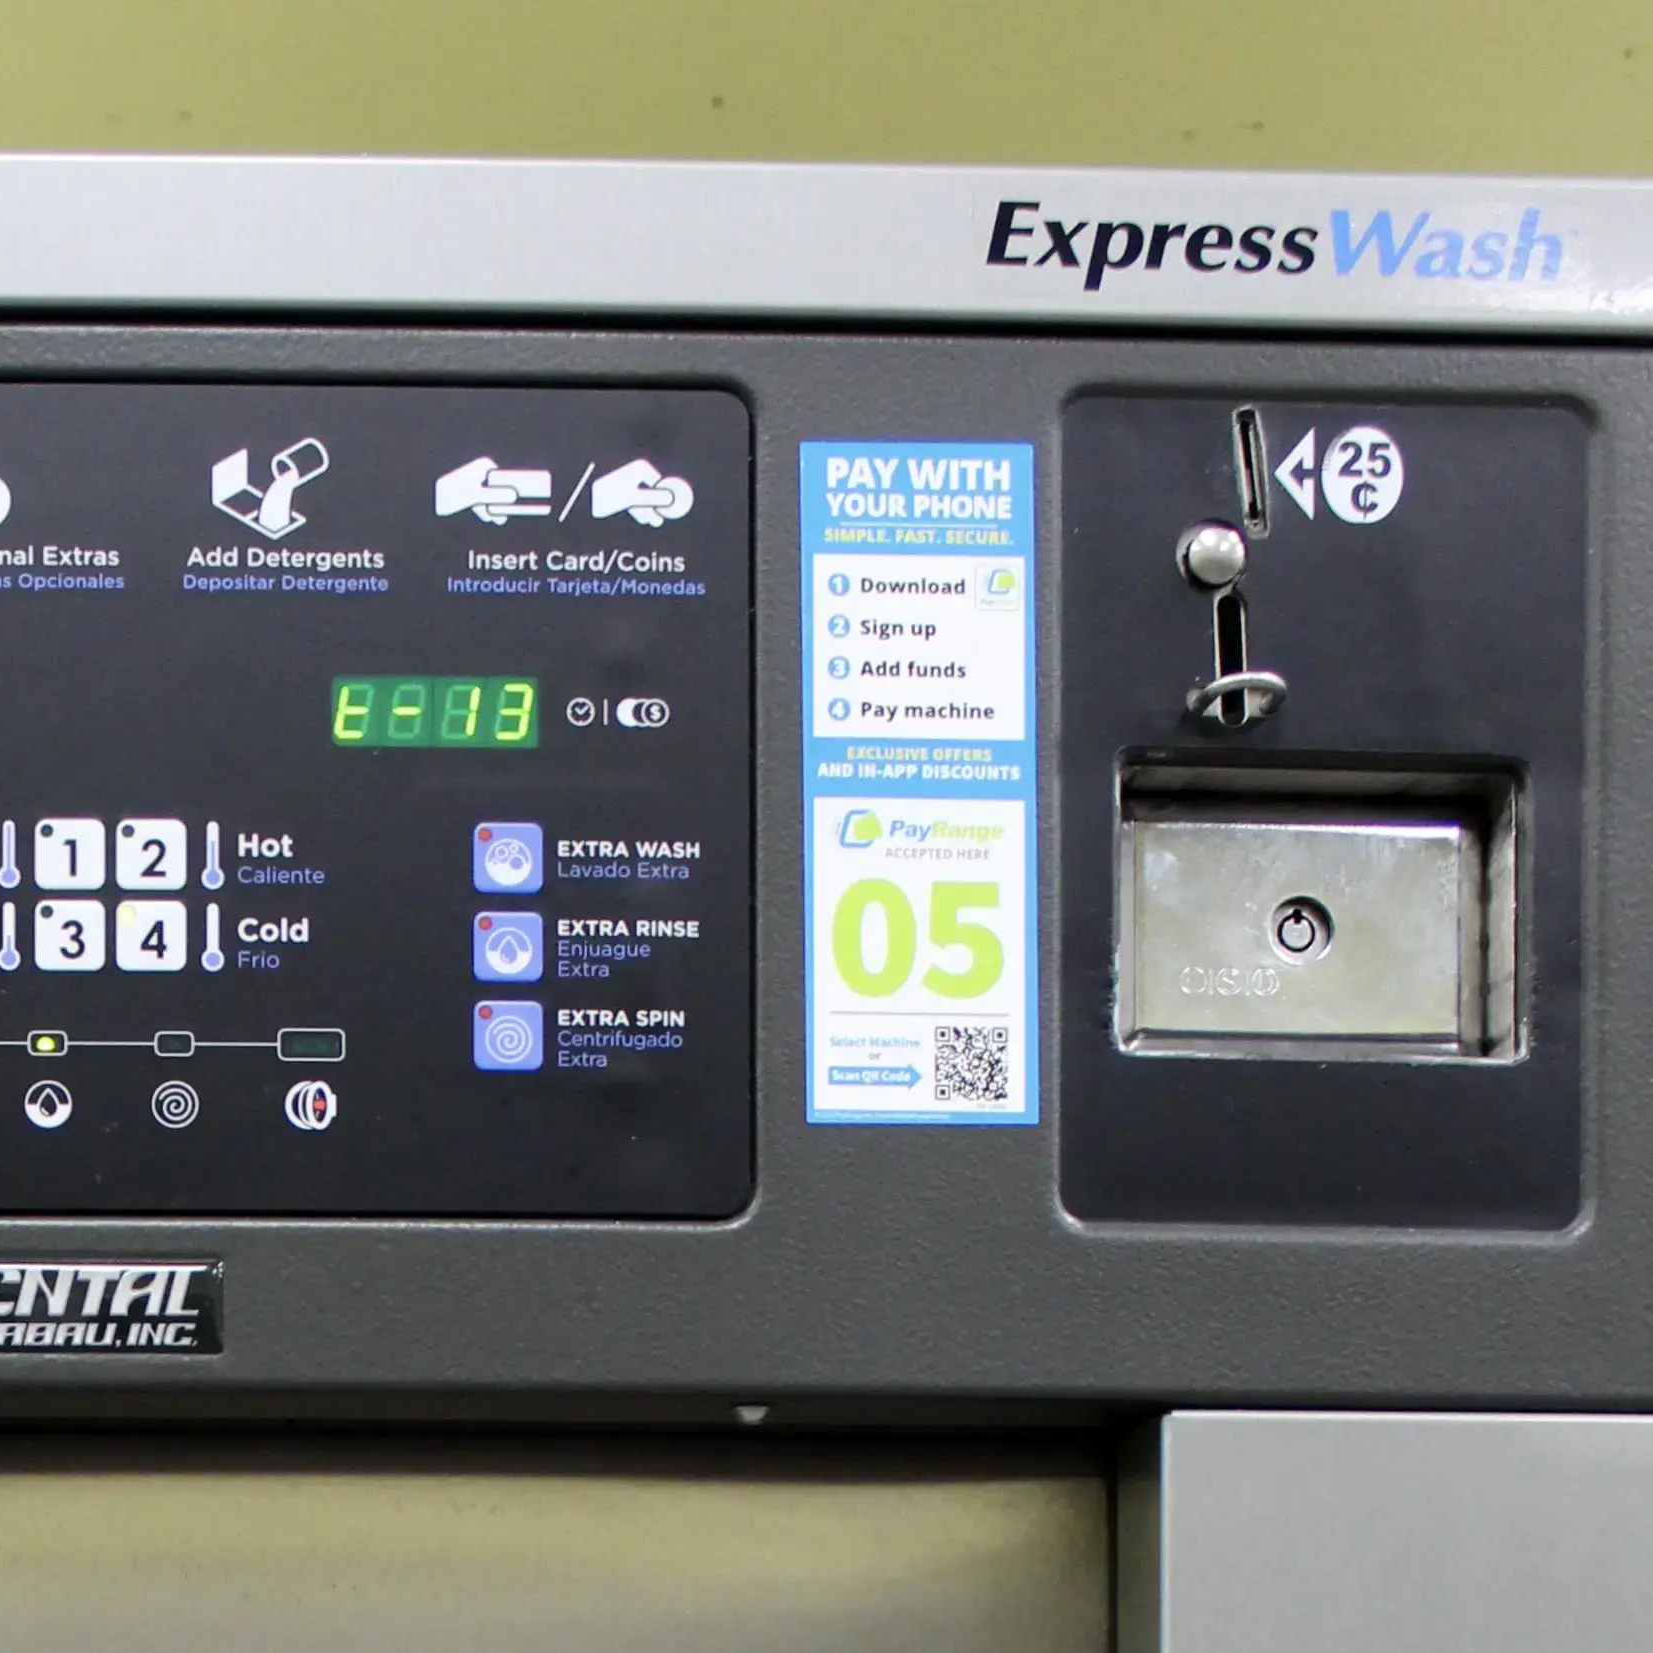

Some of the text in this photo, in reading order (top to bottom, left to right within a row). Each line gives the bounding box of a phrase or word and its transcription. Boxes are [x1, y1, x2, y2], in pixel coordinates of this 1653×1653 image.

[1335, 439, 1395, 478] 25
[825, 457, 1011, 491] PAY WITH
[824, 493, 1013, 520] YOUR PHONE
[43, 546, 119, 566] Extras
[187, 547, 384, 571] Add Detergents
[469, 550, 685, 573] Insert Card/Coins
[18, 573, 124, 590] Opcionales
[184, 574, 388, 593] Depositar Detergente
[448, 576, 705, 596] Introducir Tarjeta/Monedas
[860, 577, 965, 595] Download
[860, 619, 903, 640] Sign
[911, 622, 937, 640] up
[861, 661, 901, 677] Add
[907, 661, 966, 678] funds
[861, 702, 898, 721] Pay
[905, 703, 995, 719] machine
[847, 746, 992, 762] EXCLUSIVE OFFERS
[817, 763, 1021, 781] AND IN-APP DISCOUNTS
[888, 819, 1004, 843] PayRange
[239, 834, 293, 857] Hot
[558, 840, 699, 858] EXTRA WASH
[885, 848, 990, 860] ACCEPTED HERE
[64, 840, 76, 876] 1
[141, 839, 166, 877] 2
[238, 866, 325, 883] Caliente
[558, 862, 689, 879] Lavado Extra
[238, 918, 308, 942] Cold
[558, 920, 699, 937] EXTRA RINSE
[831, 878, 1005, 999] 05
[61, 920, 85, 959] 3
[141, 920, 167, 958] 4
[238, 951, 279, 968] Frio
[558, 940, 650, 960] Enjuague
[558, 961, 609, 977] Extra
[558, 1010, 684, 1026] EXTRA SPIN
[558, 1030, 683, 1052] Centrifugado
[559, 1051, 607, 1067] Extra
